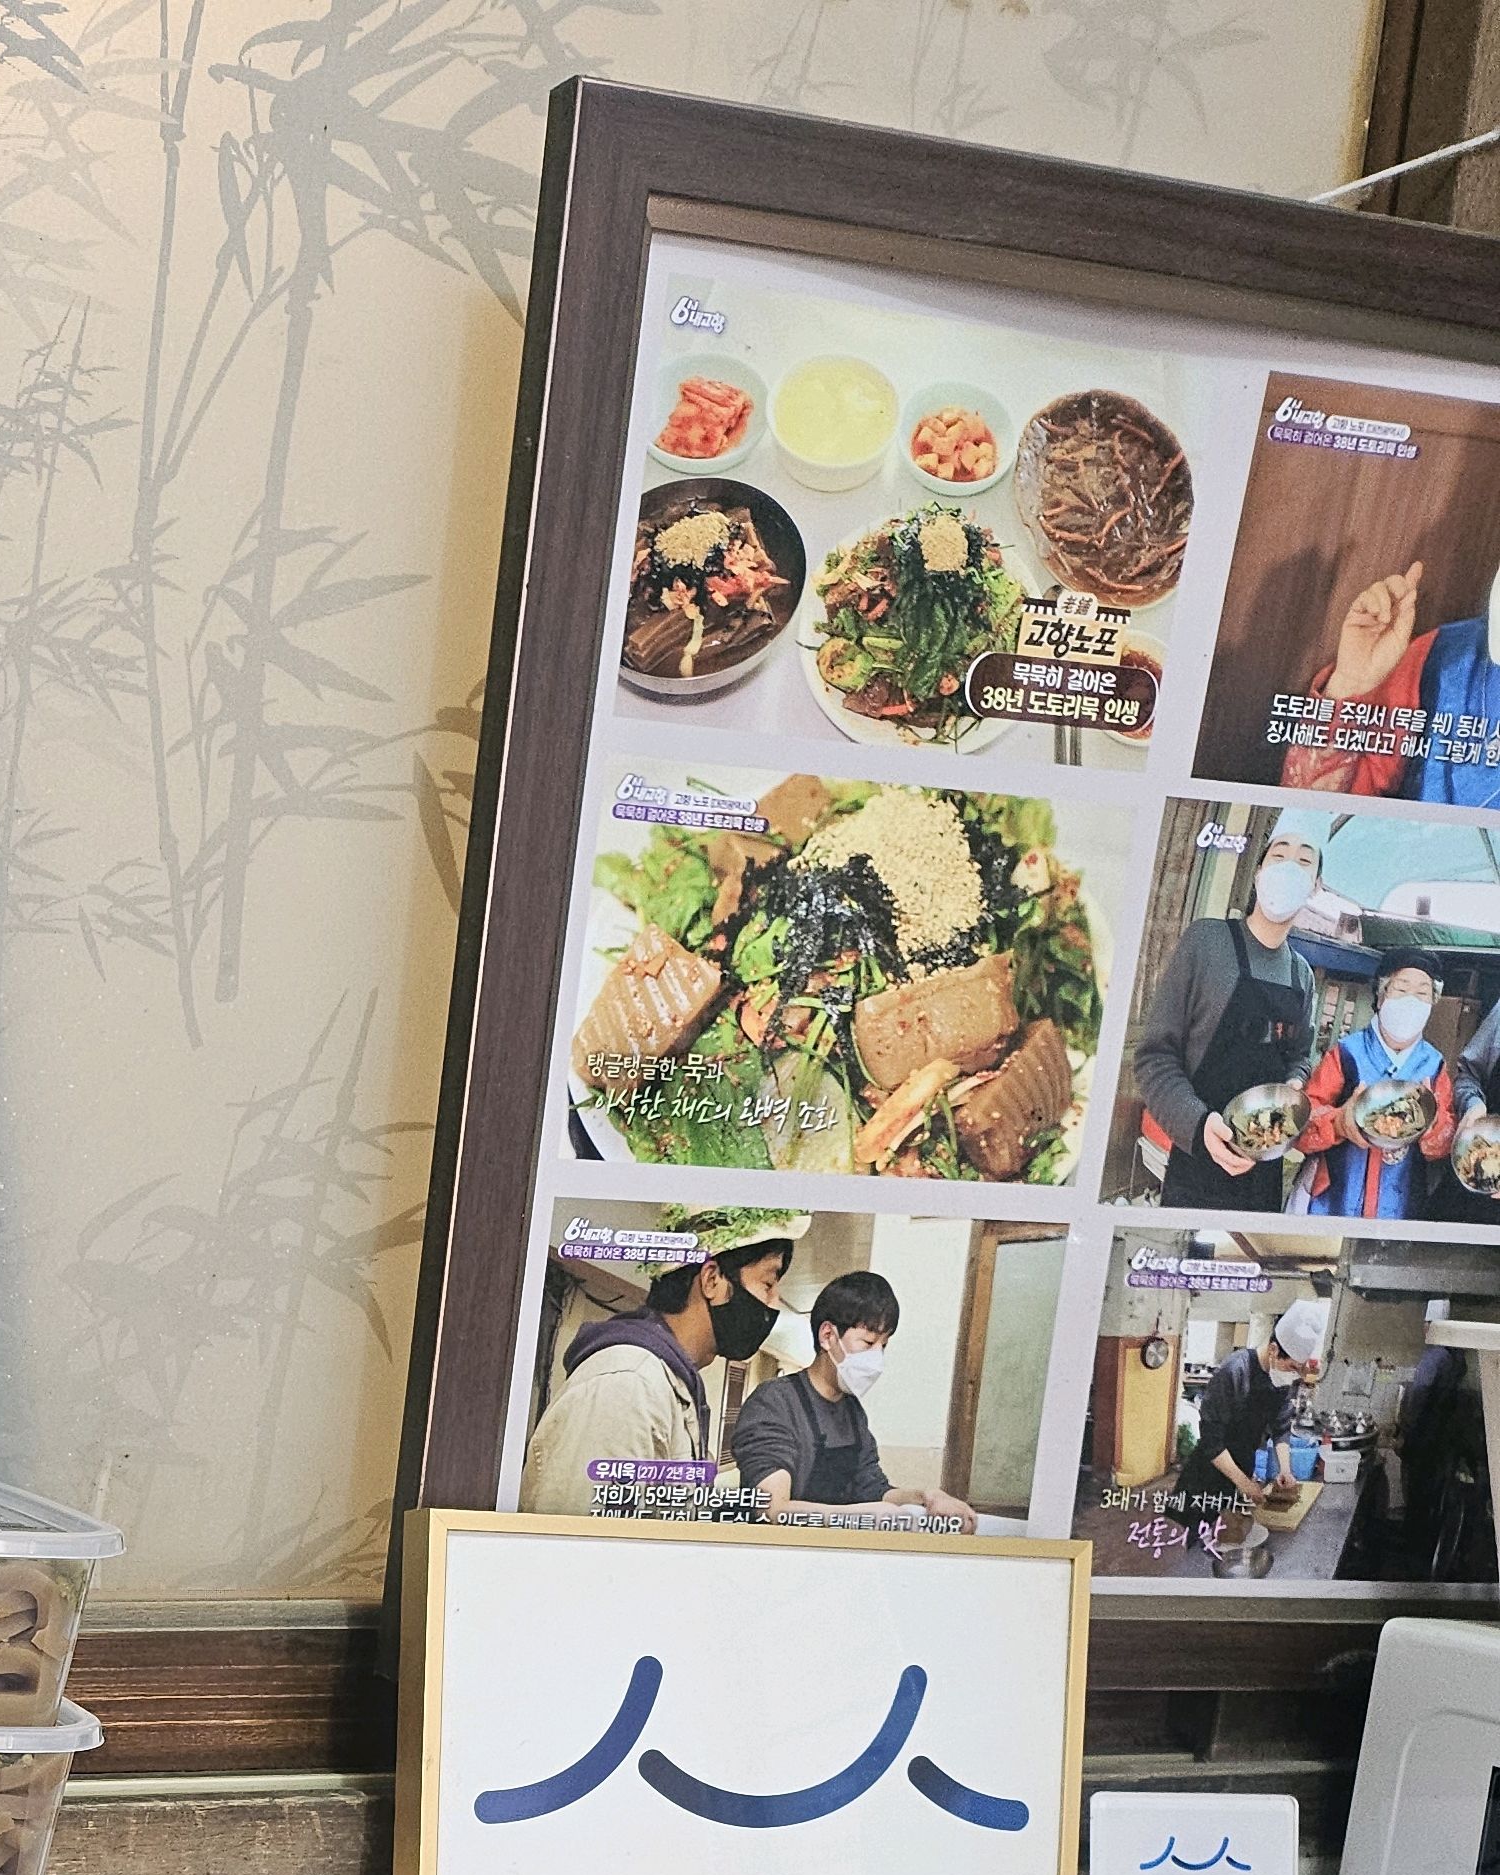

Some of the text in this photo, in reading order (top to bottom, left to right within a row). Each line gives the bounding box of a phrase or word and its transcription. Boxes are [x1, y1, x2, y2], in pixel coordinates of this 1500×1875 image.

[1024, 619, 1118, 658] 고향노포
[1013, 662, 1117, 695] 묵묵히 걸어온
[980, 686, 1140, 726] 38년 도토리묵 인생
[1271, 693, 1337, 723] 도토리를
[1339, 701, 1386, 728] 주워서
[1390, 706, 1427, 733] (묵을
[1457, 715, 1488, 739] 동네
[1266, 720, 1330, 748] 장사해도
[1334, 727, 1396, 755] 되겠다고
[1400, 736, 1432, 759] 해서
[1435, 739, 1481, 764] 그렇게
[587, 1053, 724, 1084] 탱글탱글한 묵과
[595, 1085, 838, 1133] 아삭한 채소의 완벽 조화
[596, 1462, 635, 1479] 우시욱
[637, 1466, 657, 1479] (27)
[666, 1467, 683, 1479] 2년
[685, 1467, 706, 1480] 경력
[591, 1484, 772, 1508] 저희가 5인분 이상부터는
[1100, 1486, 1148, 1512] 3대가
[1153, 1490, 1186, 1514] 함께
[1127, 1516, 1189, 1559] 전통의
